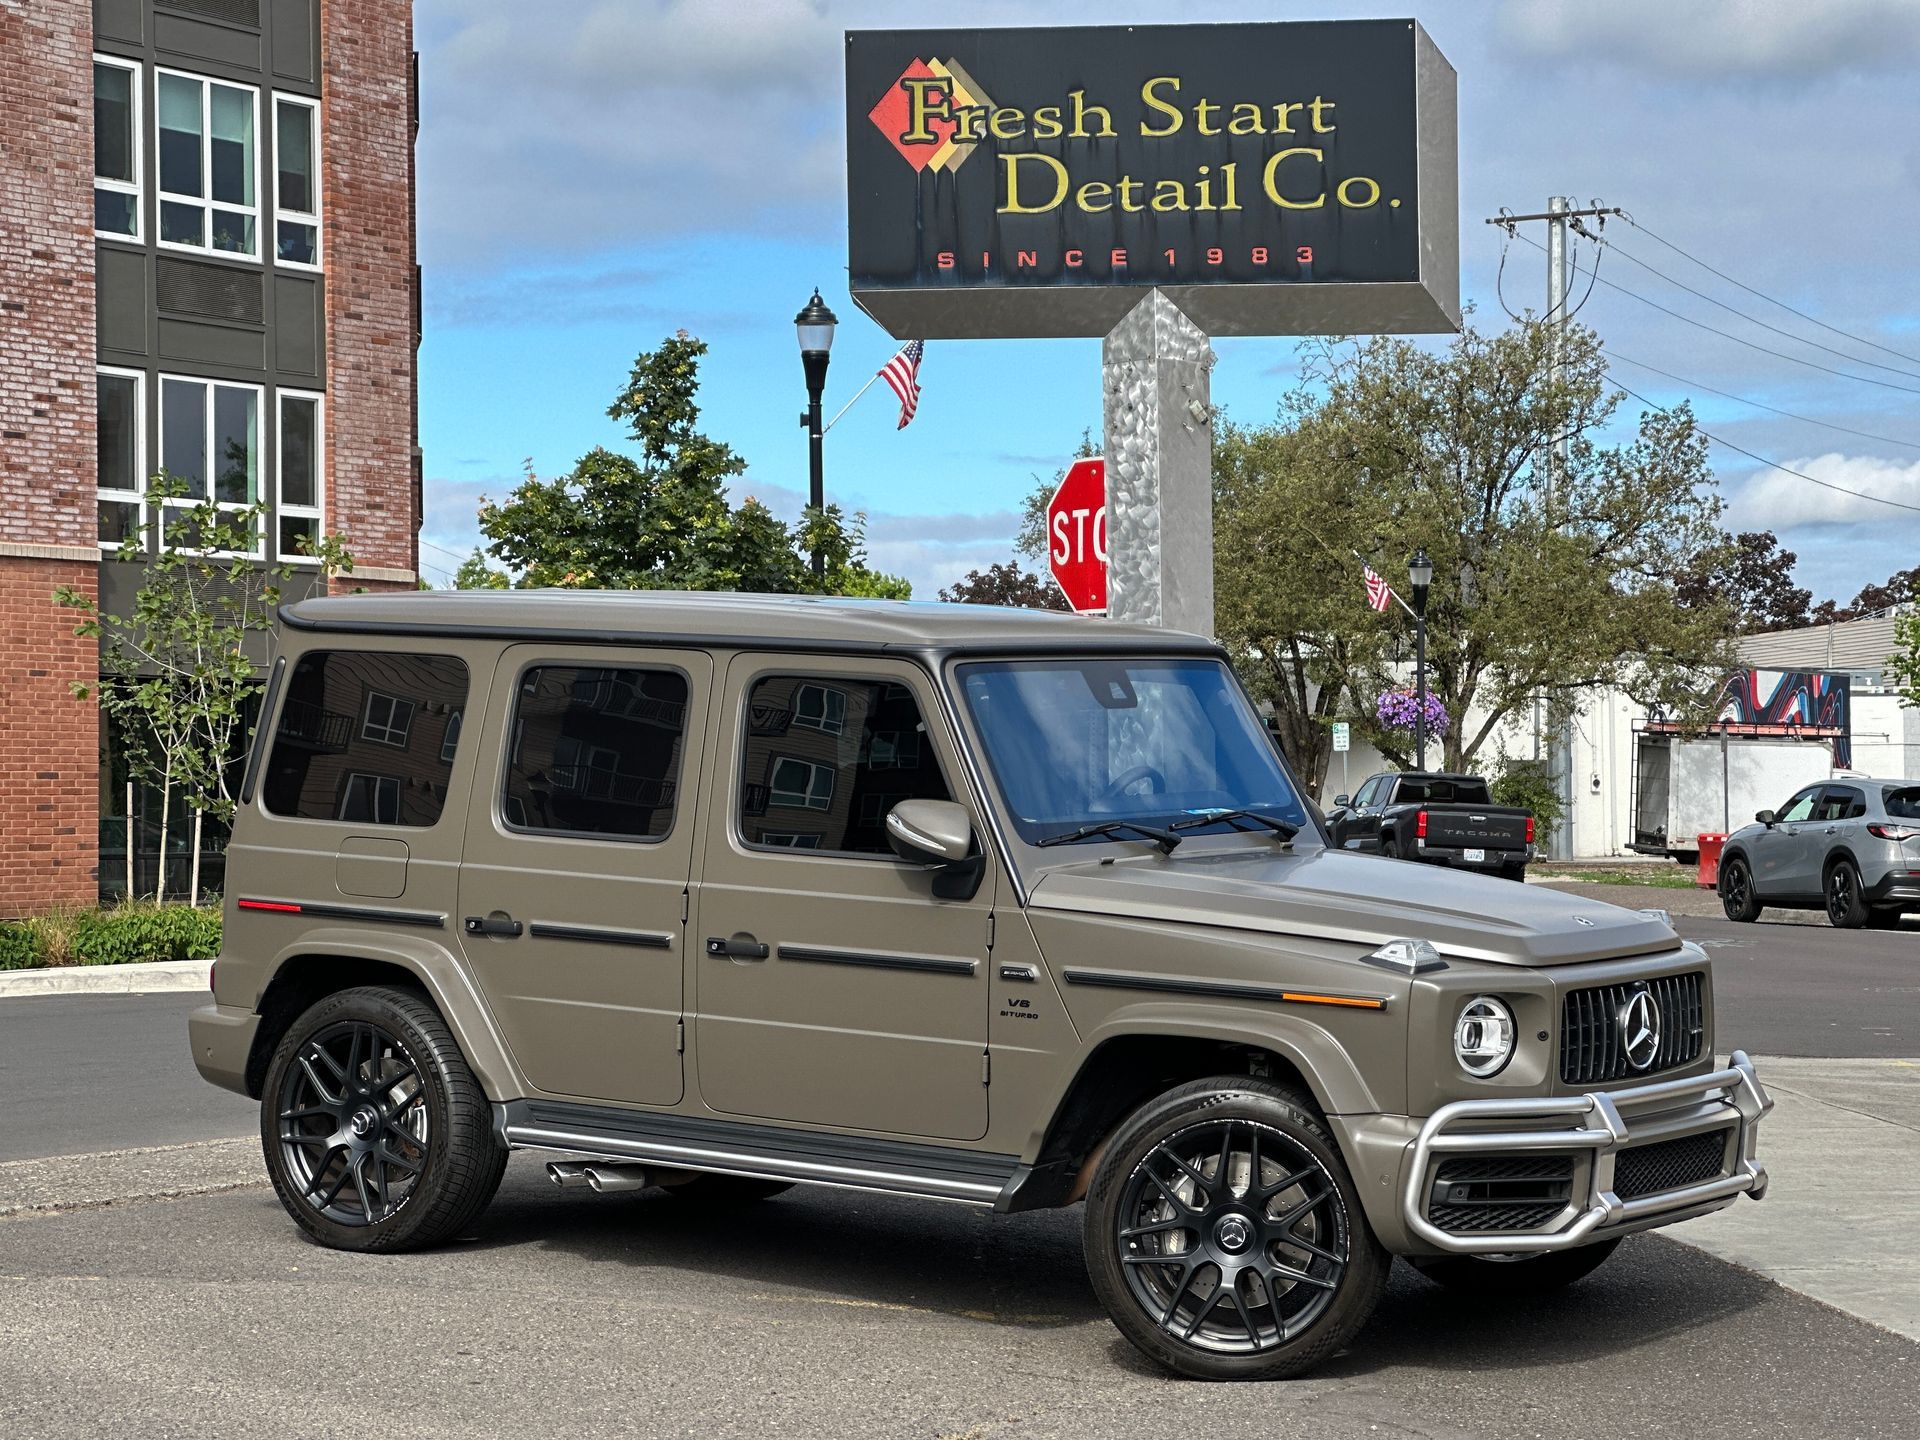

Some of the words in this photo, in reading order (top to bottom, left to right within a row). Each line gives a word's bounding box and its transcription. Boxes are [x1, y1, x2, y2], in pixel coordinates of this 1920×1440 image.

[901, 77, 1118, 144] Fresh
[1140, 77, 1336, 137] Start
[996, 153, 1243, 213] Detail
[1262, 147, 1401, 210] Co.
[937, 248, 1129, 269] SINCE
[1163, 246, 1313, 267] 1983
[1053, 506, 1107, 566] STO
[1444, 829, 1511, 838] TACOMA
[394, 1014, 438, 1073] MICHELIN
[1000, 1010, 1038, 1019] BITURBO
